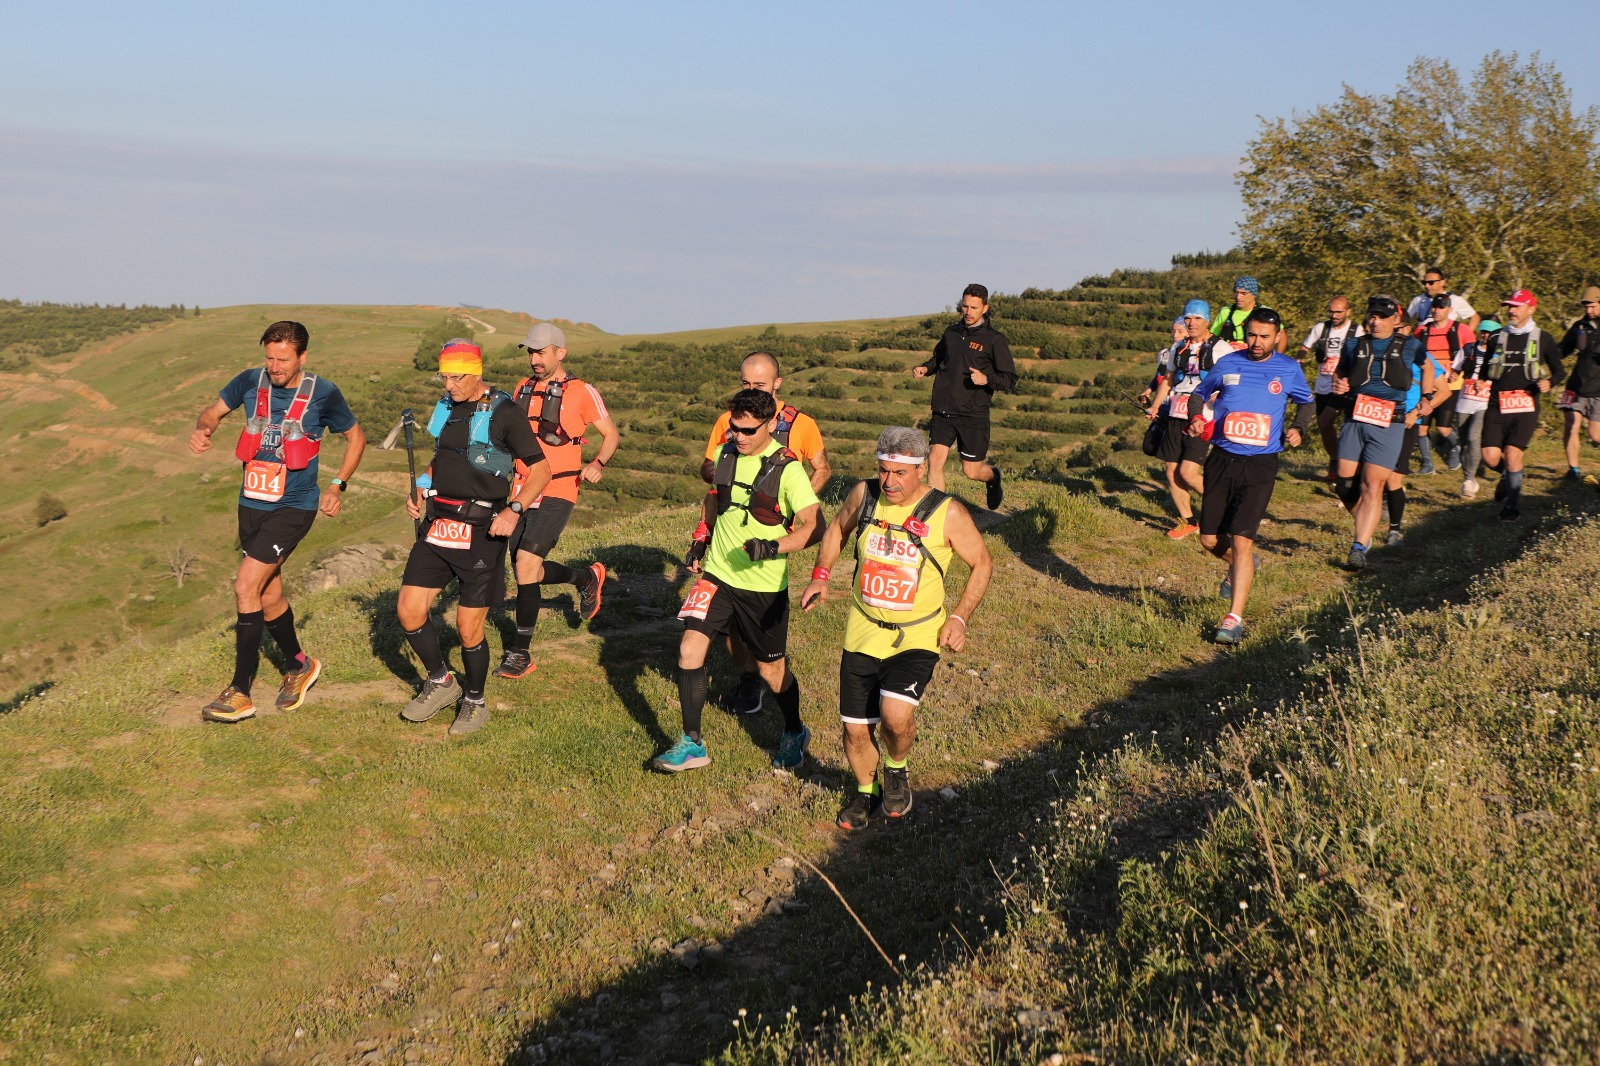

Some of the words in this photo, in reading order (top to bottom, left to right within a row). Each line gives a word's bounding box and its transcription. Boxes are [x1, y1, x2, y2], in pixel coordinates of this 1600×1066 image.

[1175, 401, 1188, 413] 10
[1355, 402, 1392, 420] 1053
[1500, 397, 1533, 409] 1003
[1225, 420, 1267, 439] 1031
[431, 519, 471, 541] 1060
[862, 572, 915, 601] 1057
